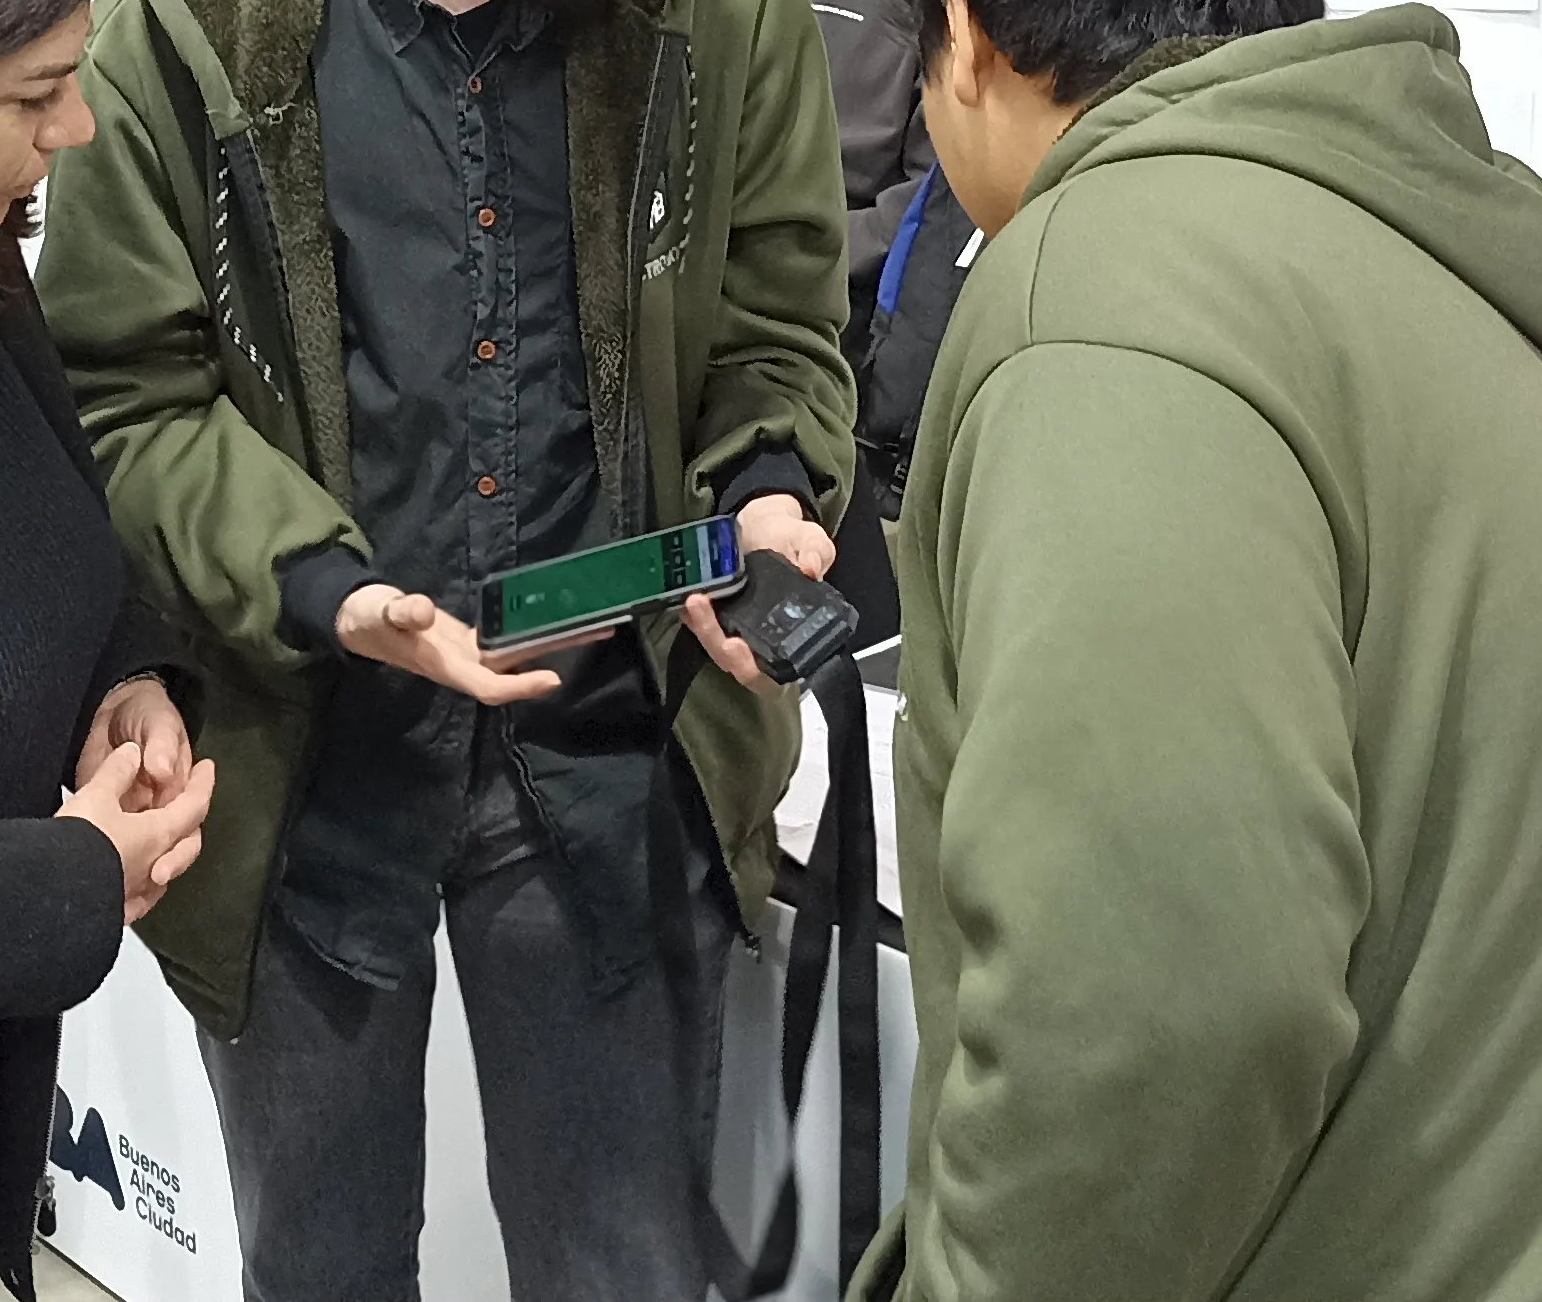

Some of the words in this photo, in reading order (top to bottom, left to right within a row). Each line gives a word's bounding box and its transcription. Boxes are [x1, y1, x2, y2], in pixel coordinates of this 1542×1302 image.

[118, 1134, 181, 1193] Buenos
[130, 1168, 176, 1215] Aires
[135, 1196, 197, 1254] Ciudad
